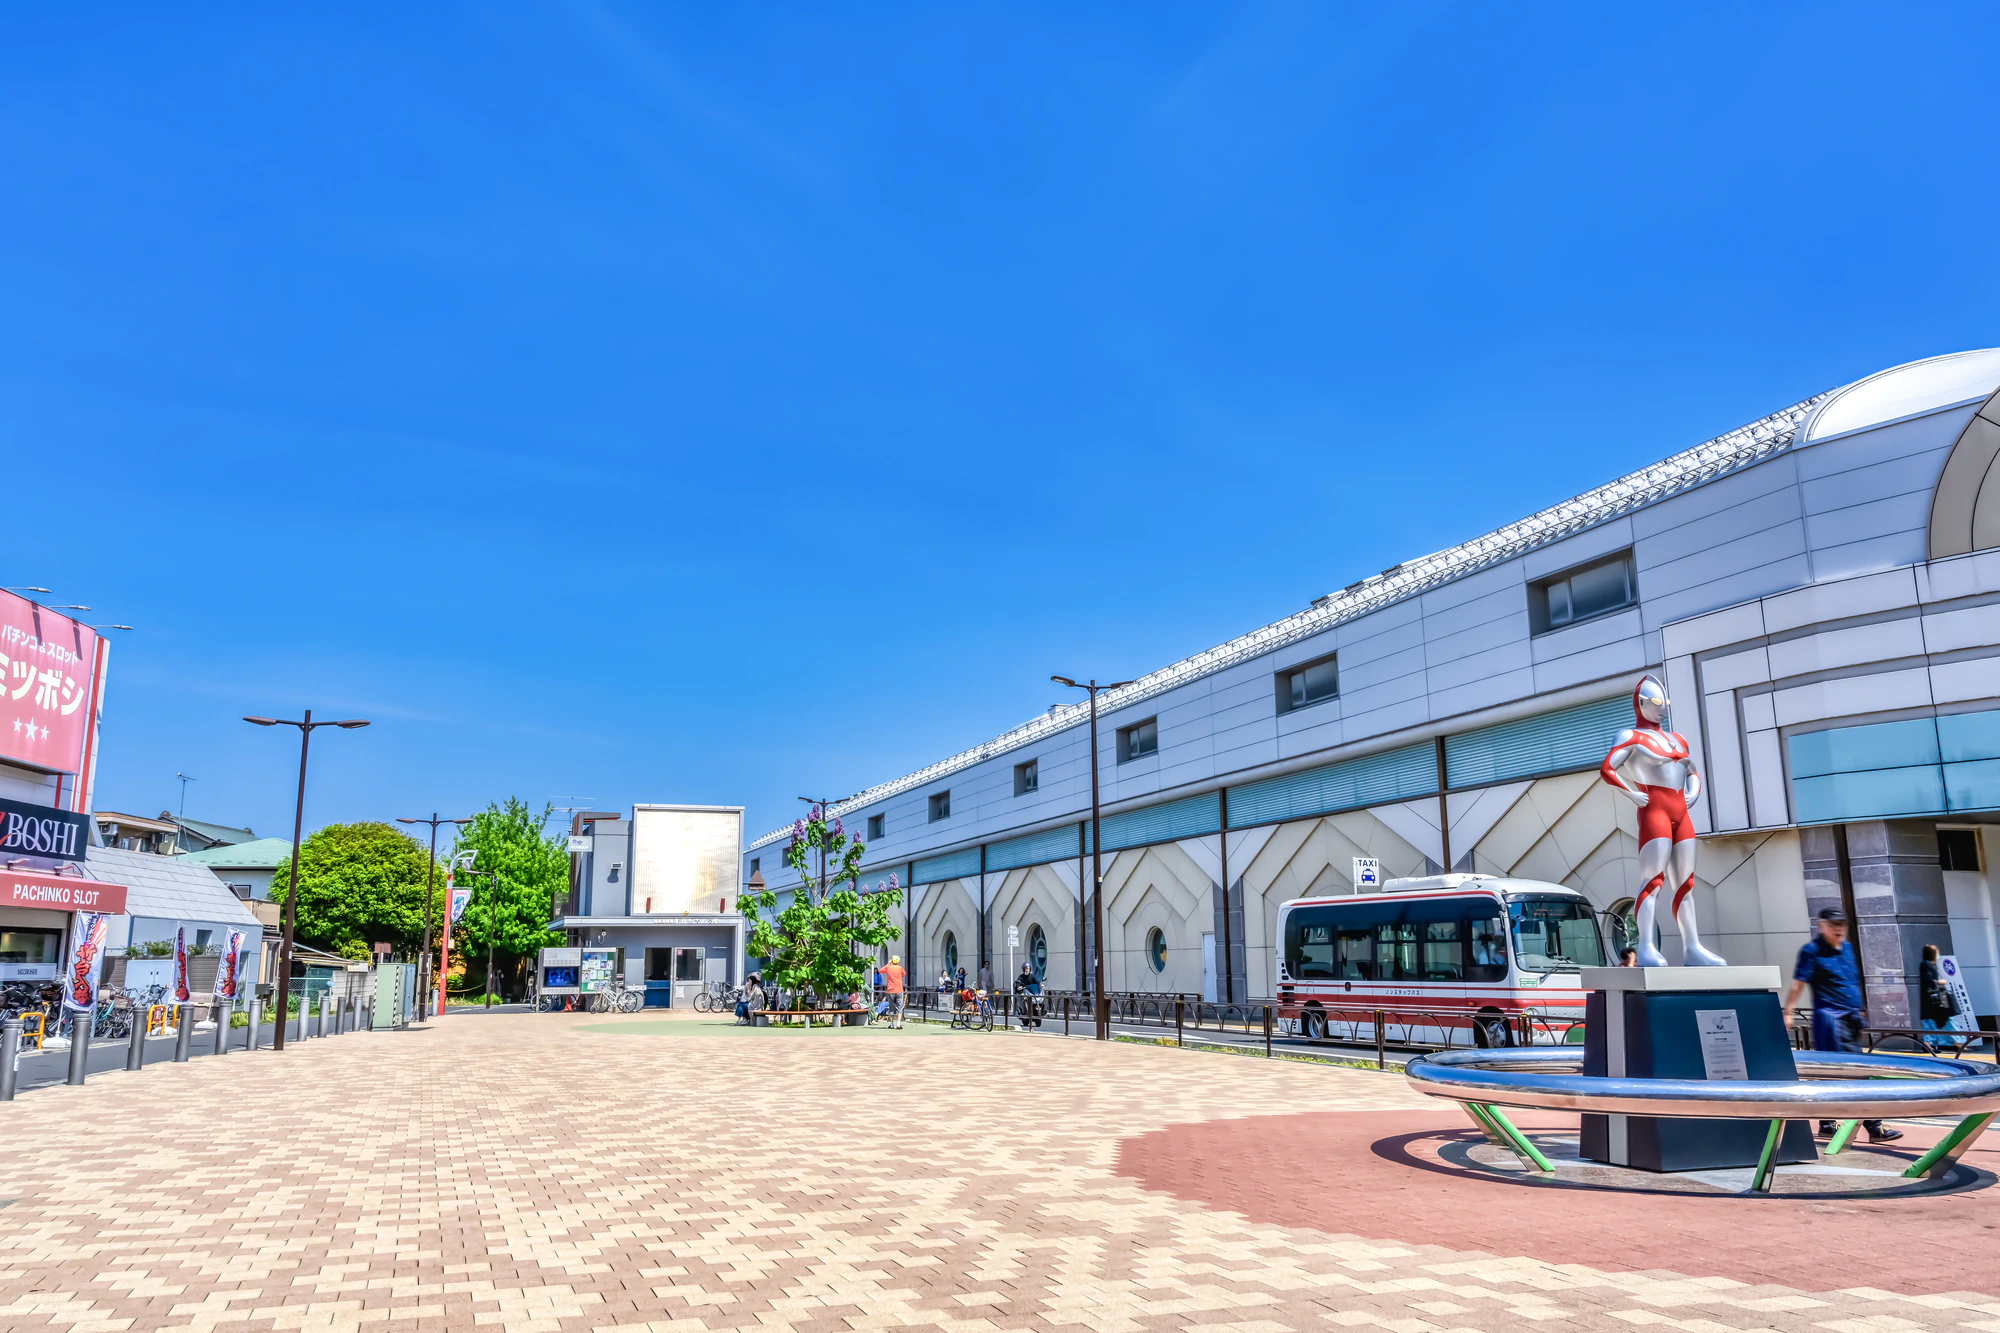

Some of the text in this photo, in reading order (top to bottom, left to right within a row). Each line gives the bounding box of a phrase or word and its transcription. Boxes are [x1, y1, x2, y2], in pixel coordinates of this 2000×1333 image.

[1358, 859, 1378, 868] TAXI
[13, 883, 100, 906] PACHINKO SLOT
